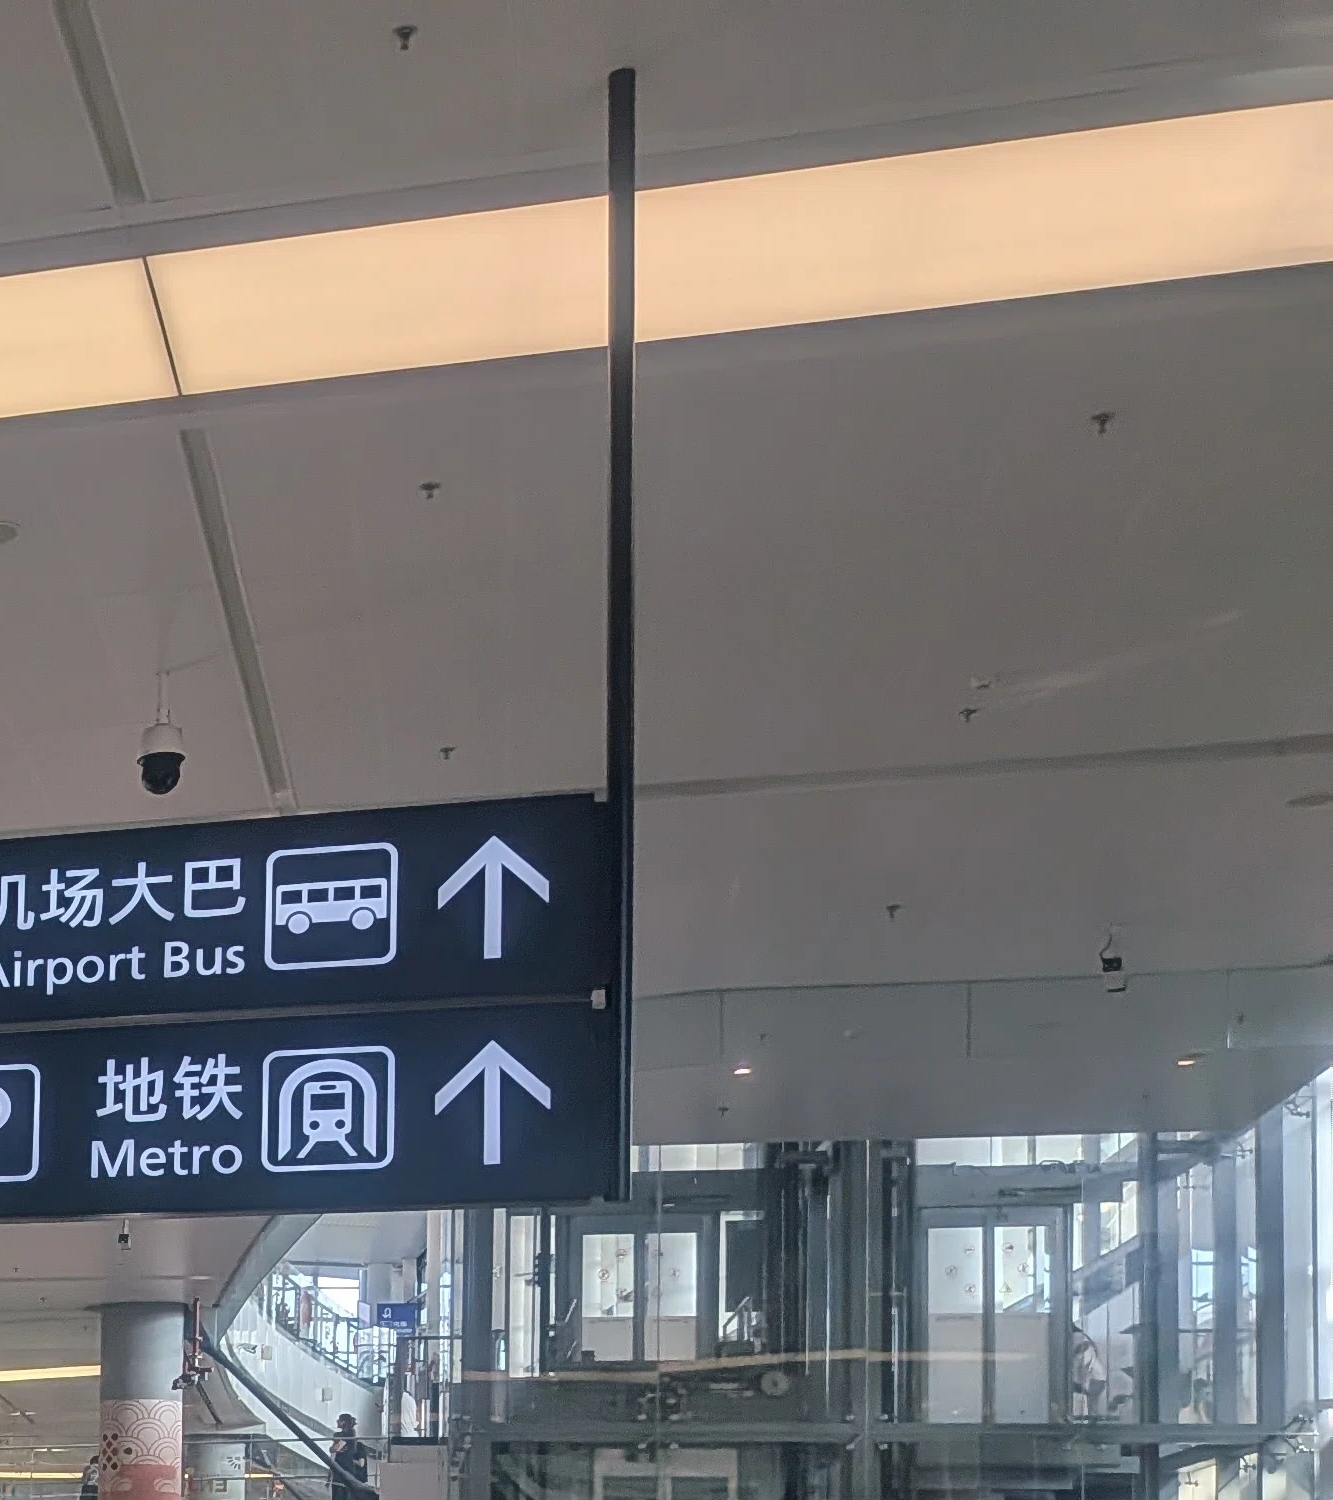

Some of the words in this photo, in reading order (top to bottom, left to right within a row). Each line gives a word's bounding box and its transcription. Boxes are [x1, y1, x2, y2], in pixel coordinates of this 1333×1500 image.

[164, 941, 245, 977] Bus
[96, 1054, 242, 1122] 地铁
[91, 1139, 242, 1178] Metro
